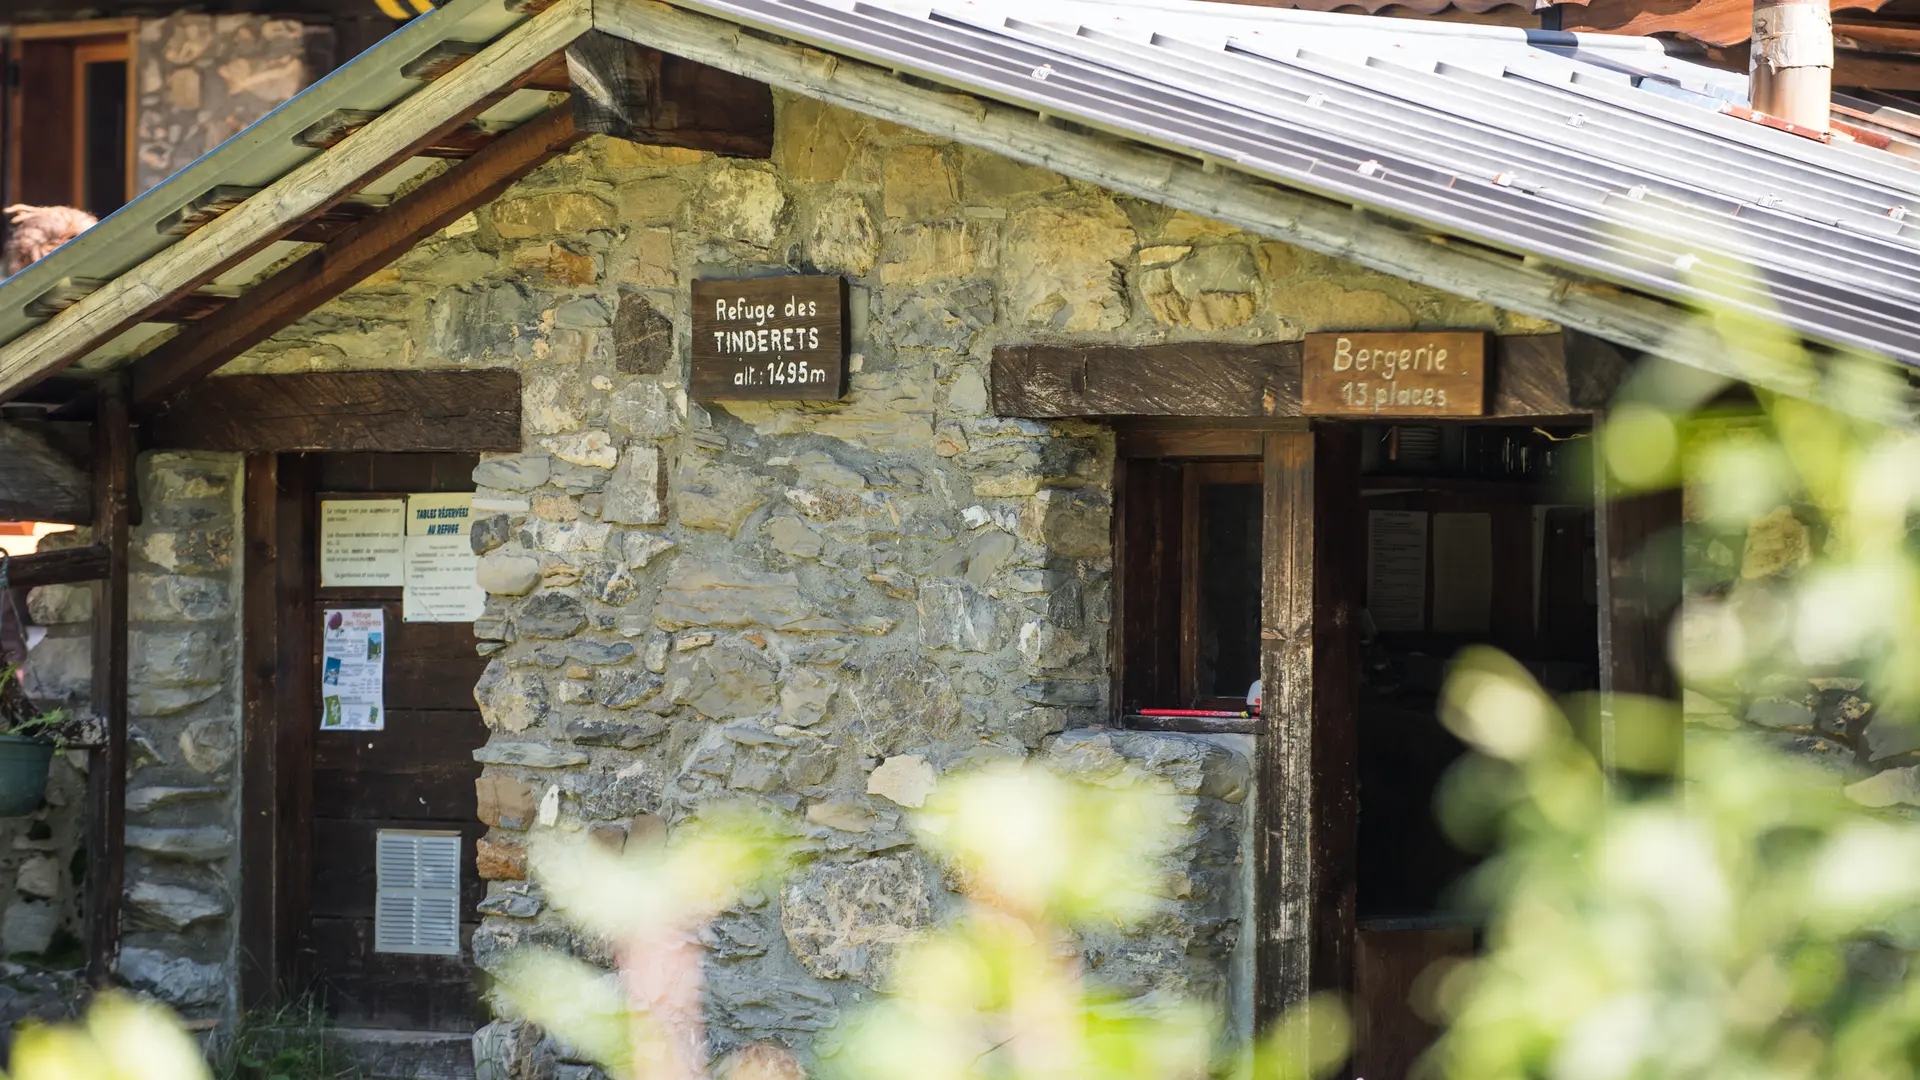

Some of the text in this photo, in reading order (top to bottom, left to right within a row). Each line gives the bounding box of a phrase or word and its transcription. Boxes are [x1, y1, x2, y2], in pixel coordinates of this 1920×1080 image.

[716, 295, 817, 327] Refuge des
[713, 327, 819, 354] TINDERETS
[1333, 337, 1448, 380] Bergerie
[1342, 381, 1447, 413] 13 places
[415, 505, 469, 520] TABLES RÉSERVÉES
[427, 523, 460, 535] AU REFUGE
